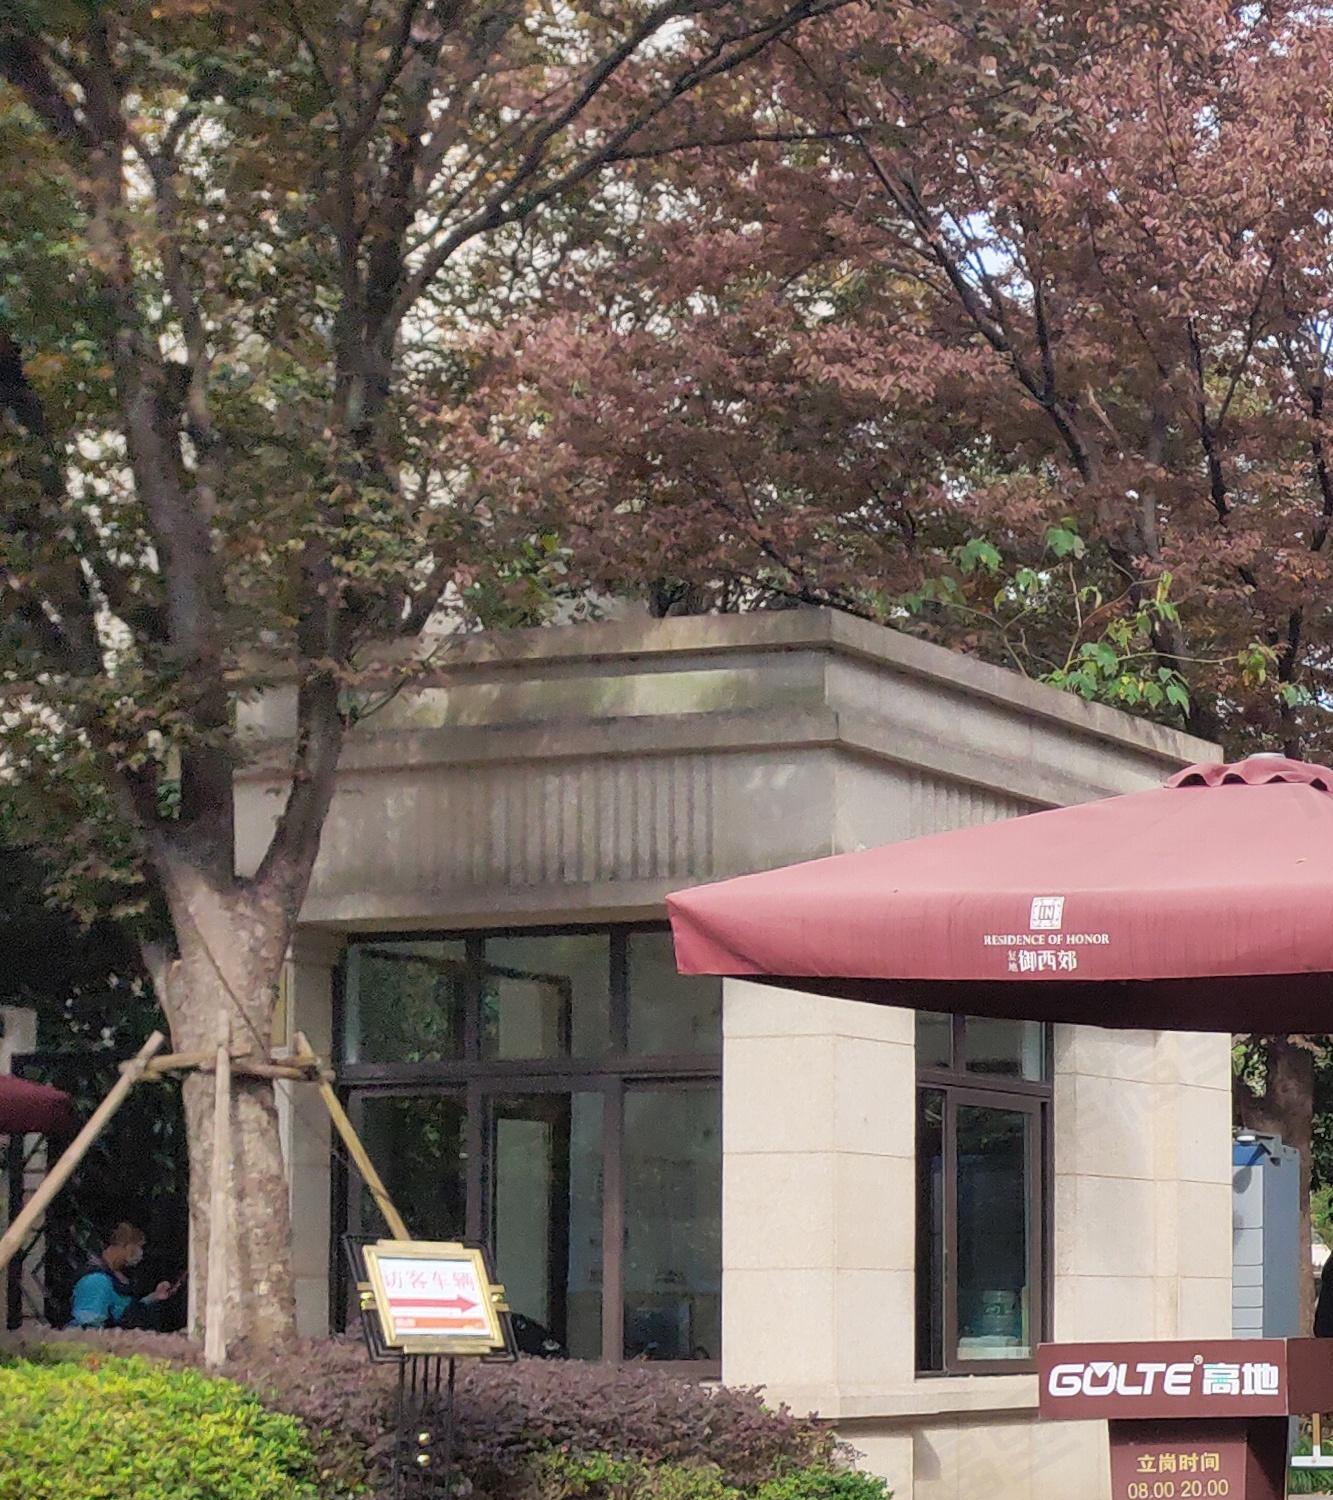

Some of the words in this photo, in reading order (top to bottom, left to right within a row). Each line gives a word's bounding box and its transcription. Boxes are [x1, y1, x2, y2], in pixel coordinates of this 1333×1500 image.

[983, 934, 1045, 946] RESIDENCE
[1048, 933, 1064, 945] OF
[1066, 933, 1110, 945] HONOR
[1048, 1361, 1195, 1397] GOLTE
[1202, 1362, 1279, 1396] 高地
[1136, 1452, 1220, 1474] 立岗时间
